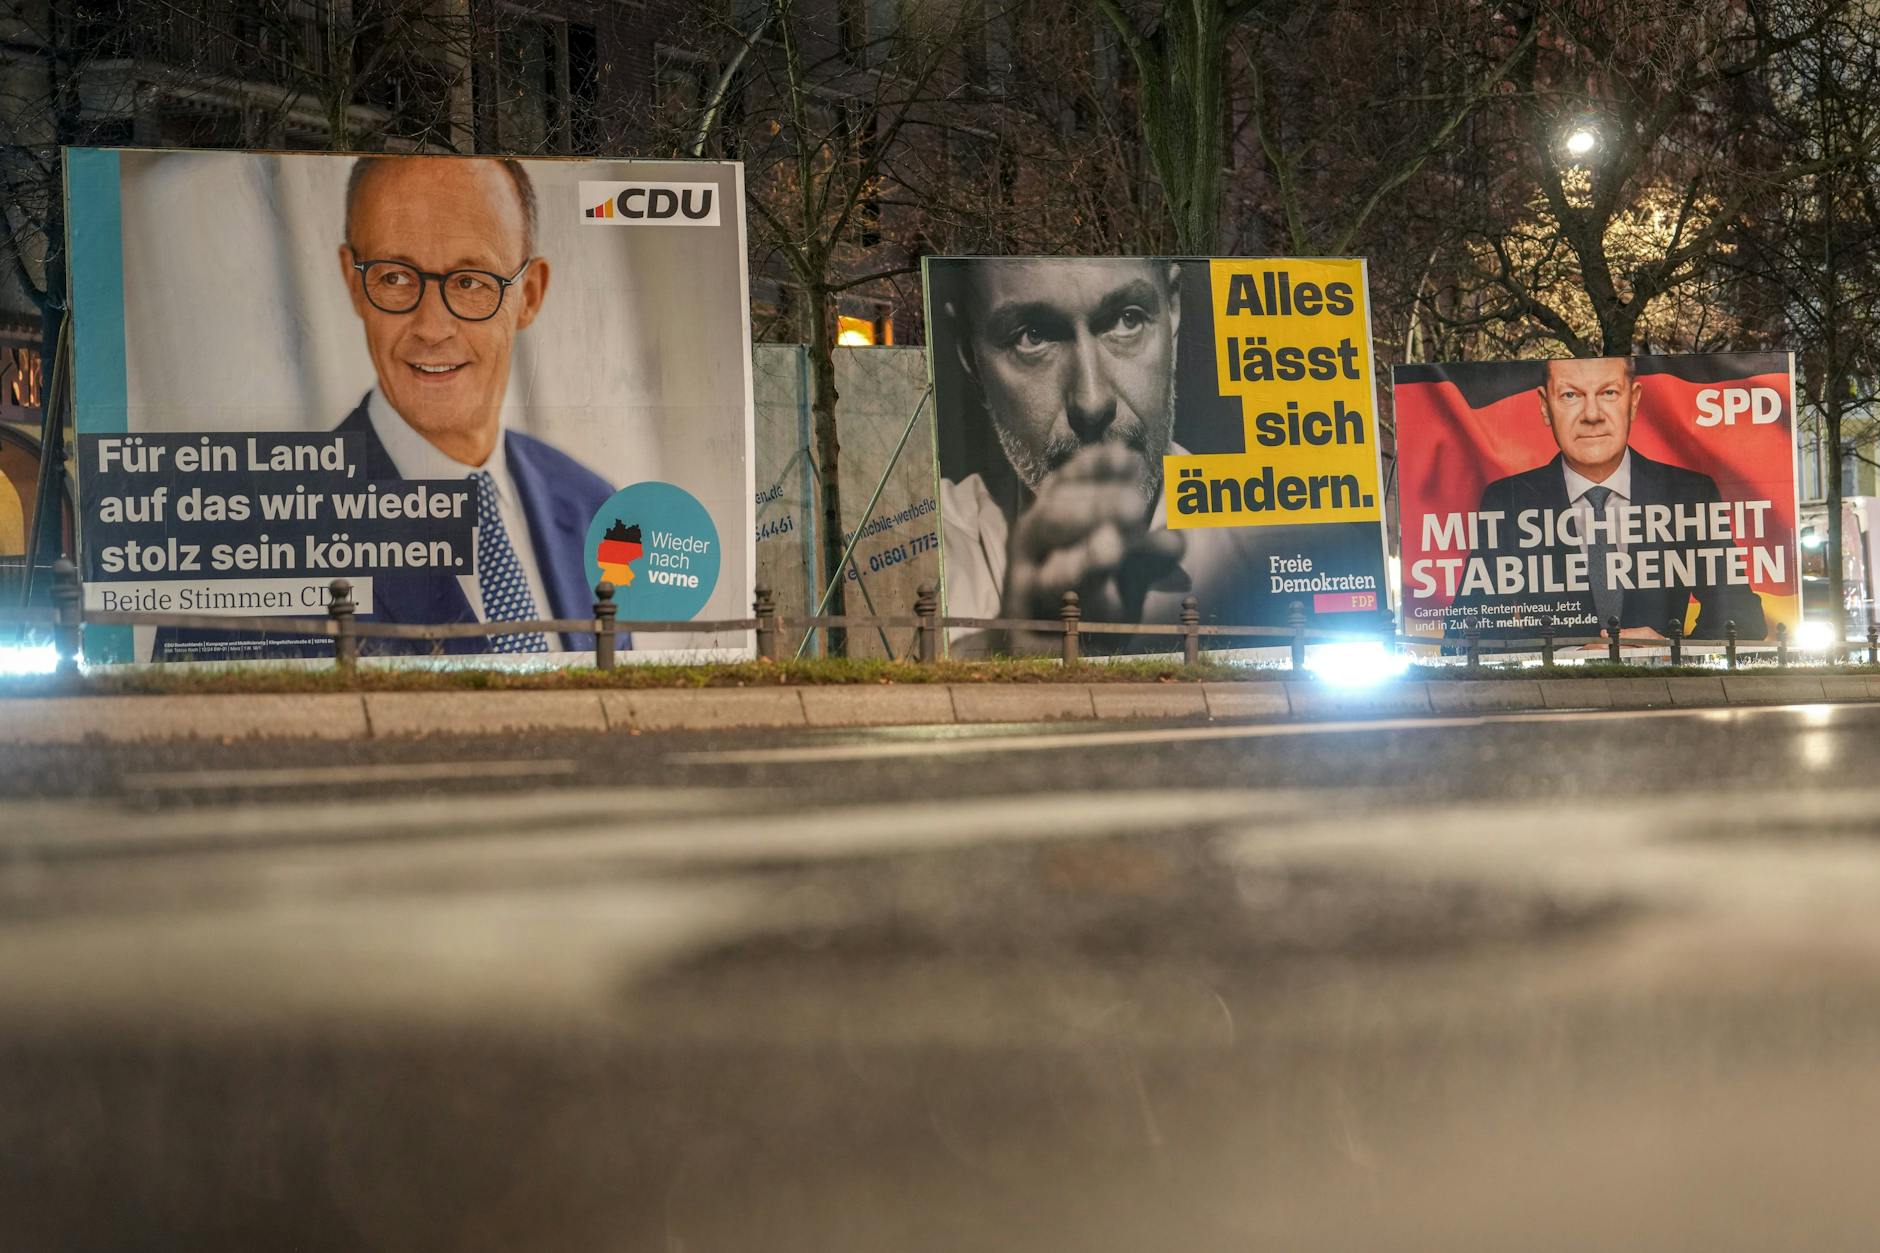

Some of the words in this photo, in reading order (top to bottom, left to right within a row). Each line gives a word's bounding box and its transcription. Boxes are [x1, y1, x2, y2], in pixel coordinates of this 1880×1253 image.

[617, 188, 712, 219] CDU
[1226, 271, 1354, 316] Alles
[1227, 336, 1360, 381] lässt
[1255, 400, 1365, 446] sich
[1695, 387, 1782, 427] SPD
[98, 437, 165, 473] Für
[175, 438, 241, 472] ein
[247, 437, 357, 478] Land,
[100, 487, 168, 523] auf
[176, 488, 251, 521] das
[261, 485, 323, 520] wir
[332, 484, 468, 519] wieder
[1176, 466, 1374, 515] ändern.
[651, 531, 710, 554] Wieder
[1421, 510, 1505, 552] MIT
[1518, 500, 1772, 548] SICHERHEIT
[101, 538, 201, 573] stolz
[211, 534, 297, 571] sein
[306, 533, 463, 569] können.
[650, 550, 690, 569] nach
[1269, 555, 1312, 574] Freie
[648, 570, 700, 588] vorne
[1270, 573, 1376, 594] Demokraten
[1411, 553, 1591, 599] STABILE
[1606, 546, 1785, 591] RENTEN
[102, 588, 172, 612] Beide
[179, 587, 294, 610] Stimmen
[1352, 595, 1375, 608] FDP
[1414, 605, 1478, 618] Garantiertes
[1481, 602, 1553, 614] Rentenniveau.
[1556, 601, 1581, 612] Jetzt
[1415, 620, 1435, 631] und
[1438, 619, 1447, 630] in
[1450, 618, 1494, 630] Zuknft:
